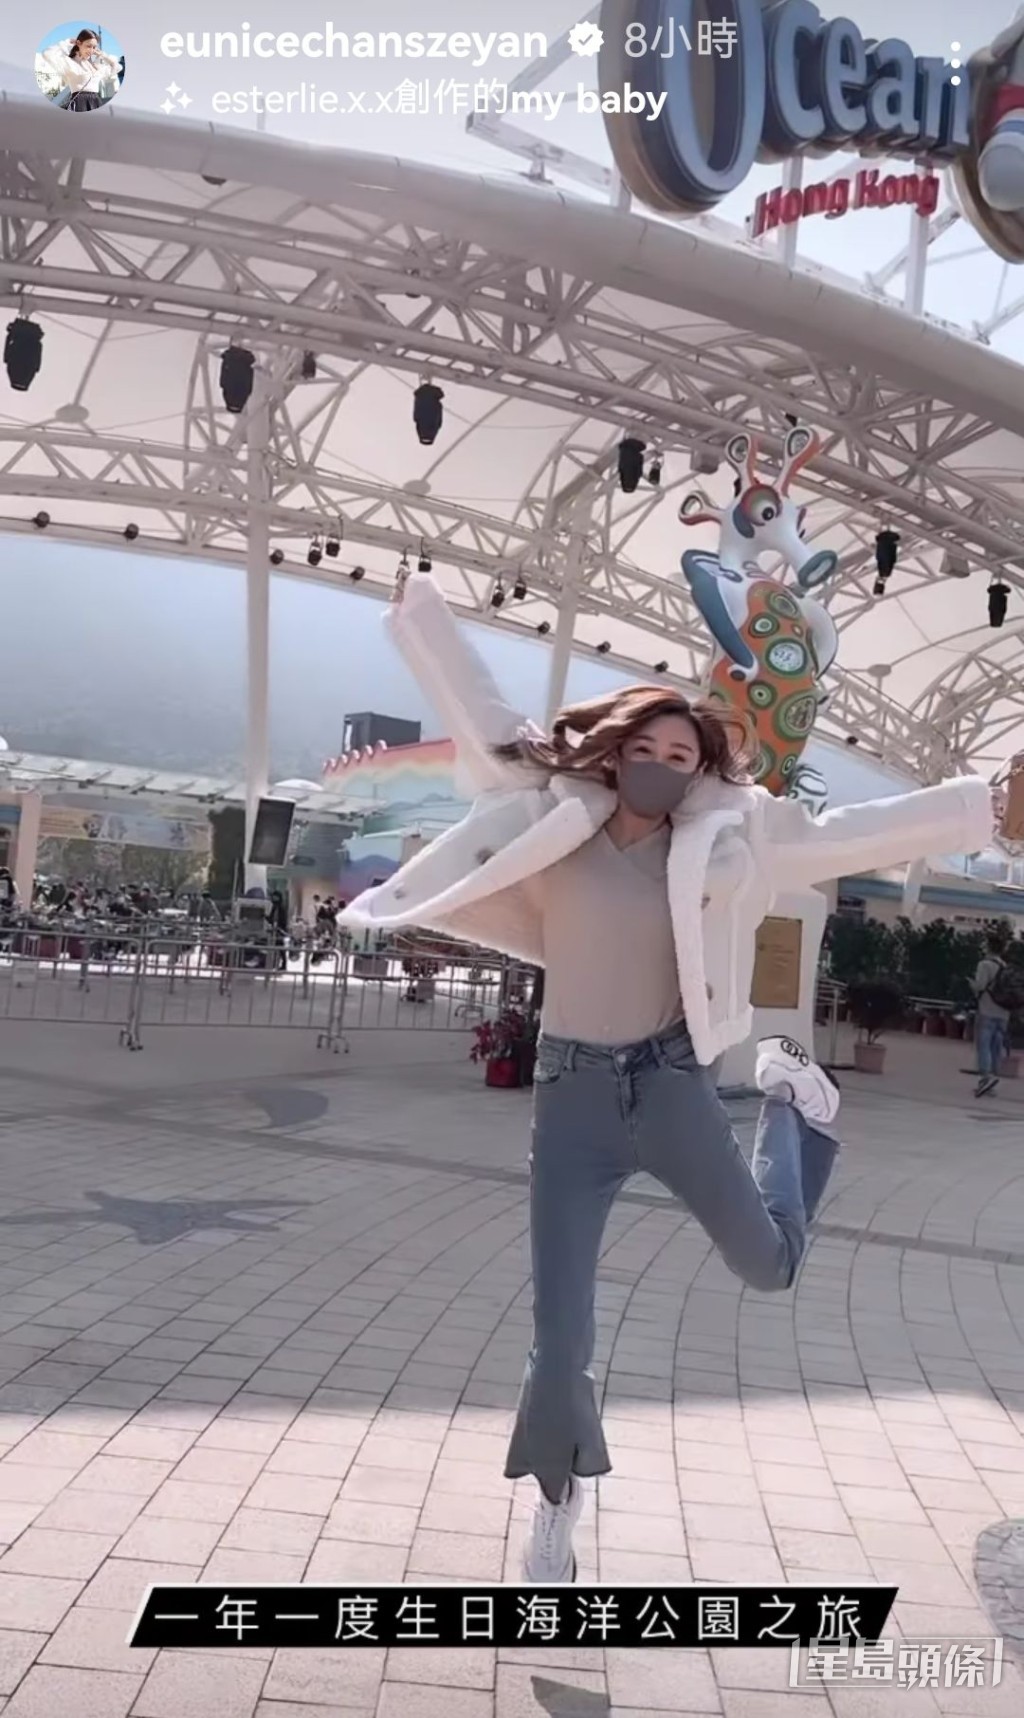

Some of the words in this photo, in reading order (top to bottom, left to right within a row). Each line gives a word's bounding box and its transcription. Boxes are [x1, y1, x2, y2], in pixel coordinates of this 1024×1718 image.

[630, 0, 972, 200] Ocean
[752, 174, 850, 238] Hong
[853, 168, 940, 219] Kong
